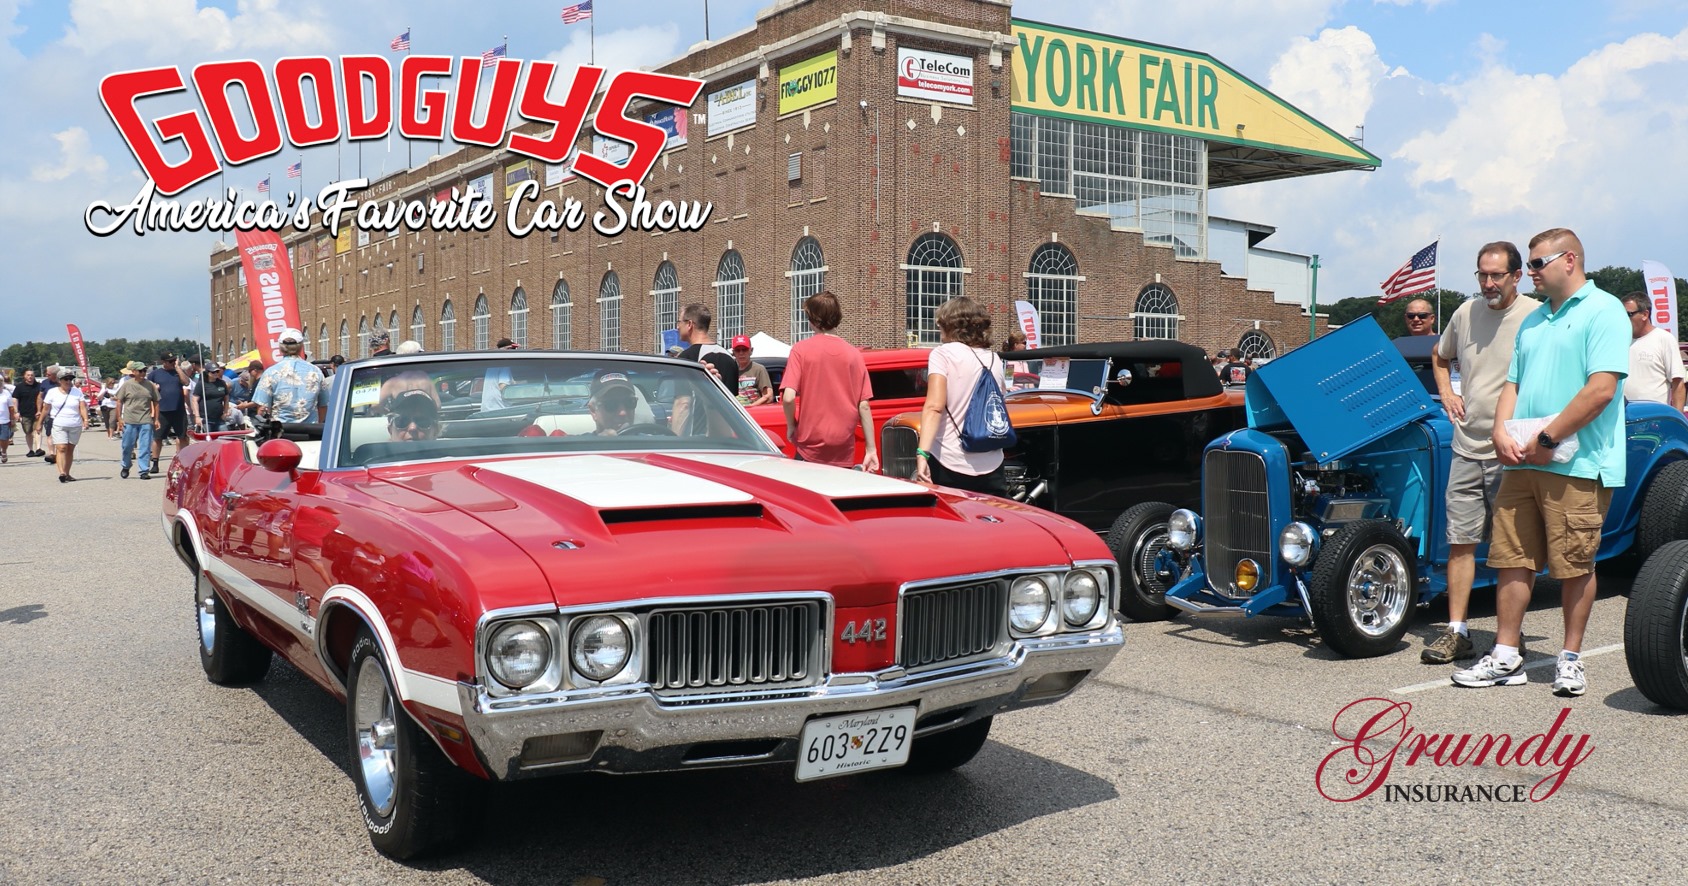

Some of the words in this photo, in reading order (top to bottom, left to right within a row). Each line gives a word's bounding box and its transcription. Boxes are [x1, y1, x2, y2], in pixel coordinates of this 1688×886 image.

[919, 58, 970, 76] TeleCom
[780, 65, 836, 99] FRGGY107.7
[918, 80, 971, 97] telecomyork.com
[1017, 32, 1126, 116] YORK
[1139, 53, 1220, 130] FAIR
[841, 617, 887, 643] 442
[838, 714, 881, 731] Maryland
[807, 732, 849, 764] 603
[863, 724, 907, 755] 2Z9
[836, 759, 871, 770] Historic
